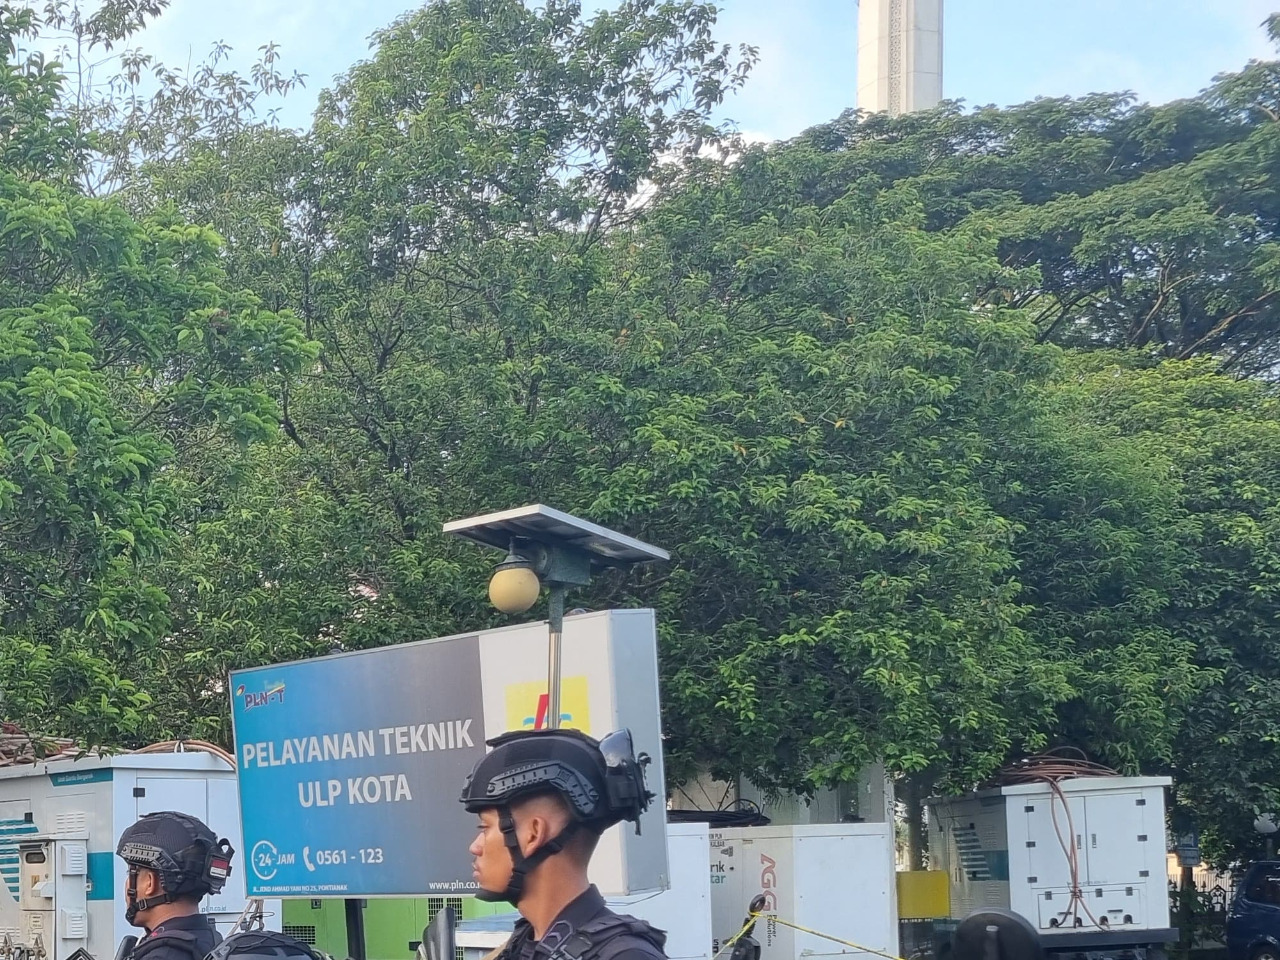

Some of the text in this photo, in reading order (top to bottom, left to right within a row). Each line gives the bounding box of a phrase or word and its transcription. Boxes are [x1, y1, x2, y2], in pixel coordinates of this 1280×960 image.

[243, 719, 474, 768] PELAYANAN TEKNIK
[298, 774, 413, 808] ULP KOTA
[258, 853, 295, 866] 24 JAM
[316, 850, 347, 865] 0561
[359, 848, 384, 864] 123
[428, 879, 480, 891] www.pln.co.i
